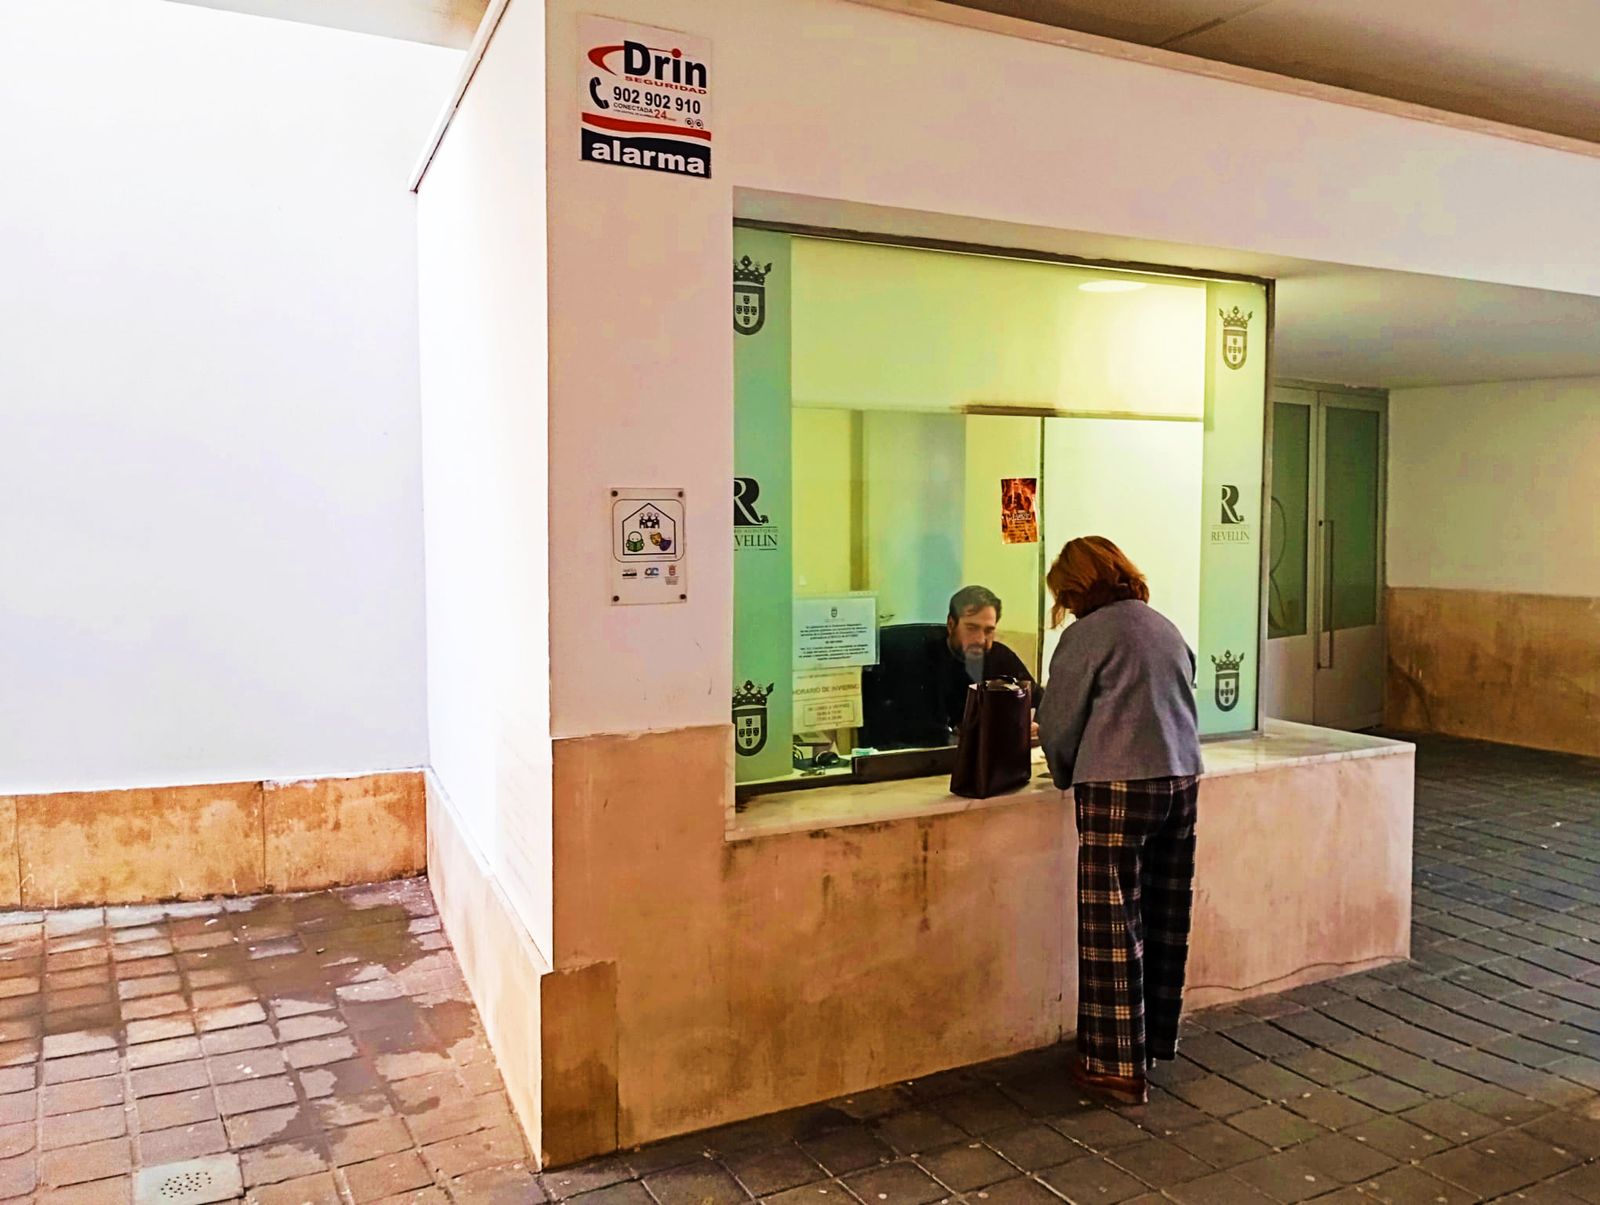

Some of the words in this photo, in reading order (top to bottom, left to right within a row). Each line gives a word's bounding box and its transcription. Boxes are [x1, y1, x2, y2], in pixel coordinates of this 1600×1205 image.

[624, 40, 706, 88] Drin
[625, 76, 707, 95] SEGURIDAD
[613, 86, 640, 104] 902
[644, 91, 671, 110] 902
[675, 97, 701, 114] 910
[613, 102, 654, 114] CONECTADA
[654, 109, 668, 120] 24
[591, 140, 705, 175] alarma
[734, 534, 778, 547] VELLIN
